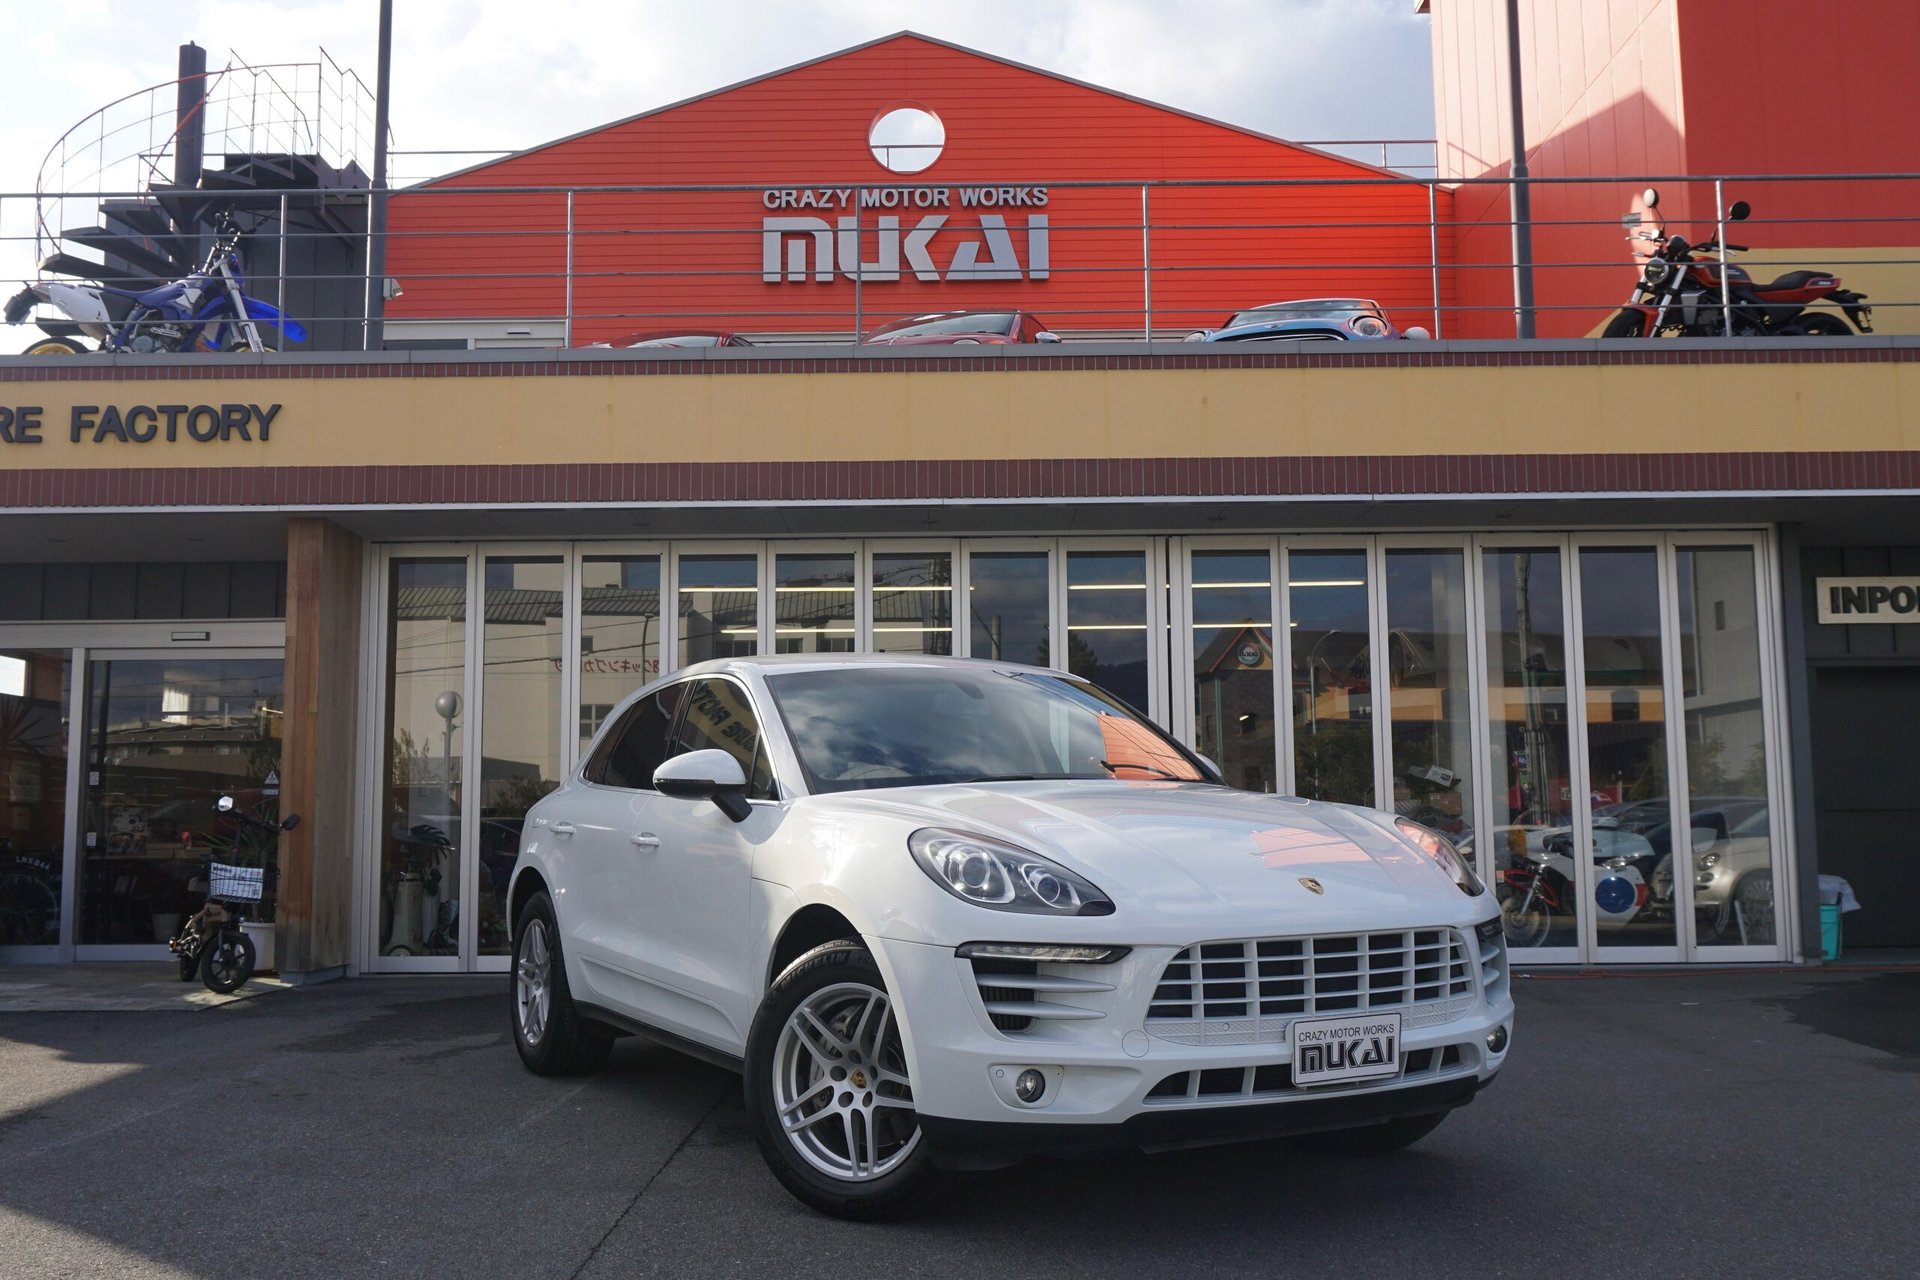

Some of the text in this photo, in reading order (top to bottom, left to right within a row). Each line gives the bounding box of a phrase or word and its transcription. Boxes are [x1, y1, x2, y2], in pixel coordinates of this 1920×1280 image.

[763, 187, 1048, 209] CRAZY MOTOR WORKS
[763, 214, 1049, 281] MUKAI
[0, 403, 282, 443] RE FACTORY
[1830, 586, 1920, 614] INPO
[1298, 1024, 1395, 1042] CRAZY MOTOR WORKS
[1299, 1036, 1395, 1074] MUKAI
